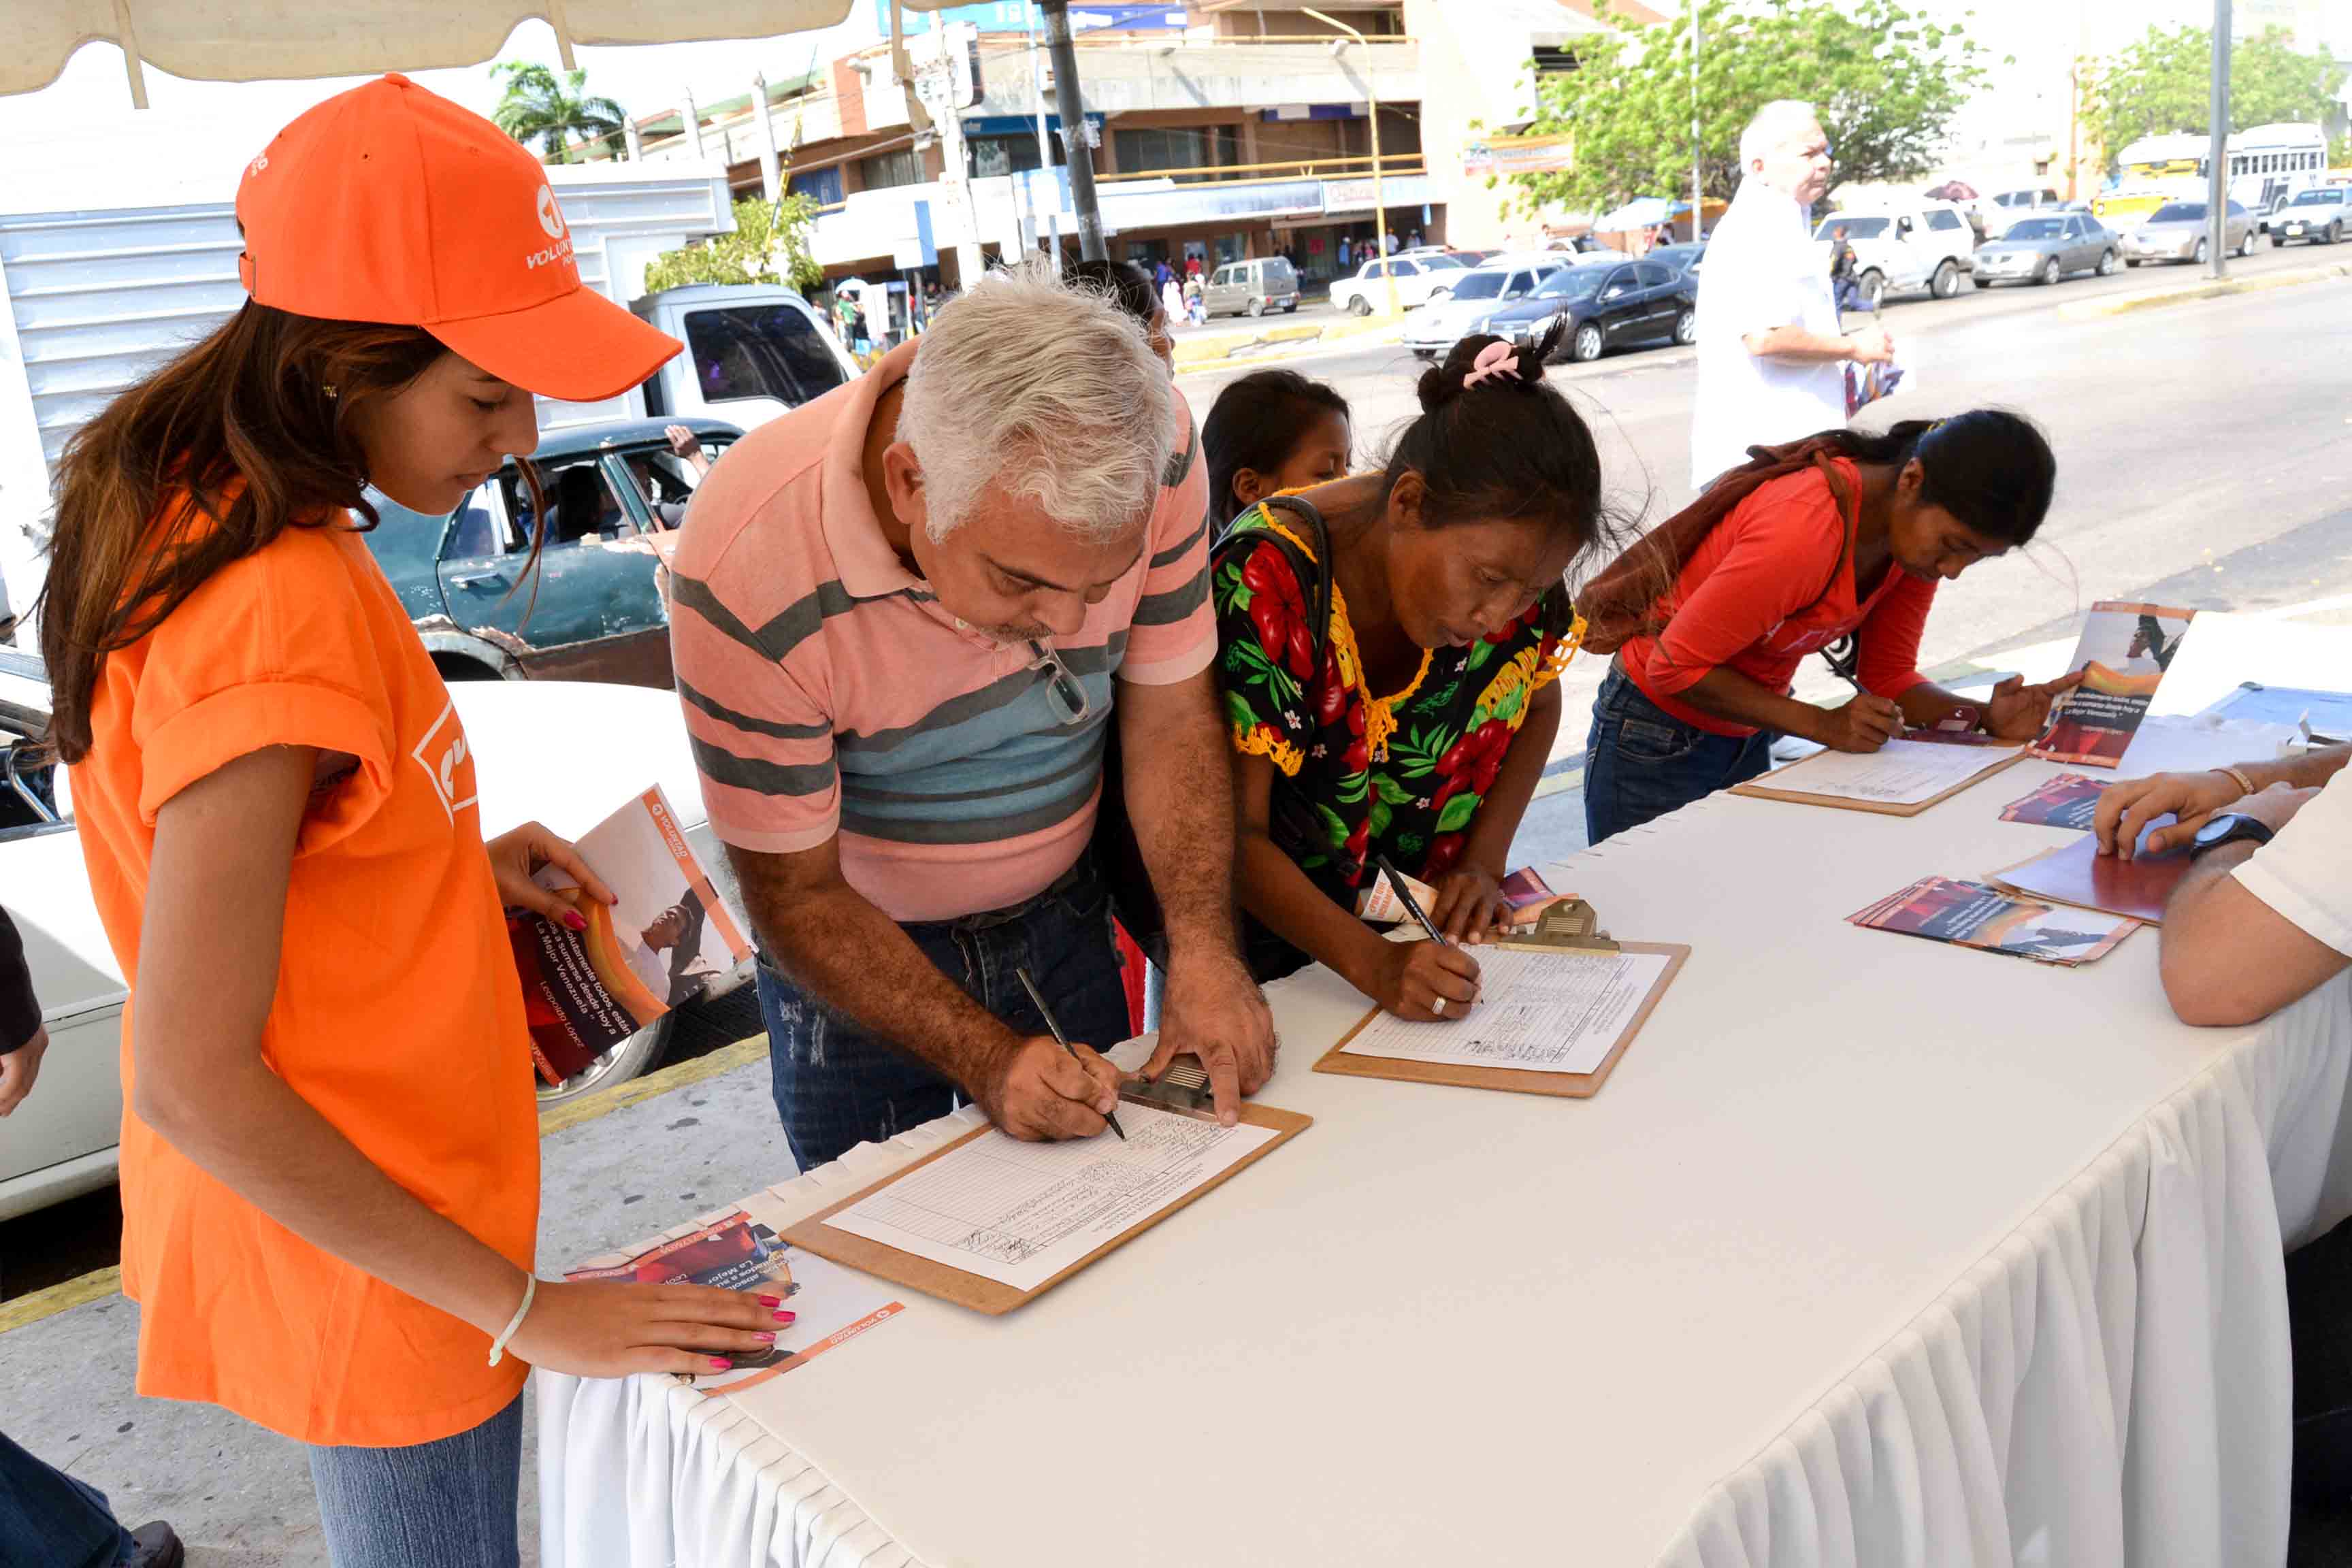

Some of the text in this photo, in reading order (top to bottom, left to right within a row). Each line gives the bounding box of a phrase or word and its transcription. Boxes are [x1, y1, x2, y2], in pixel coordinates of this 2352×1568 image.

[536, 920, 545, 935] La
[542, 934, 560, 964] Mejor
[556, 964, 589, 1014] Venezuela
[558, 942, 583, 981] sumarse
[579, 982, 600, 1010] desde
[597, 1009, 612, 1028] hoy
[540, 981, 585, 1048] Leopoldo López
[593, 981, 612, 1011] todos,
[611, 1011, 632, 1035] están
[708, 1260, 753, 1286] La Mejor
